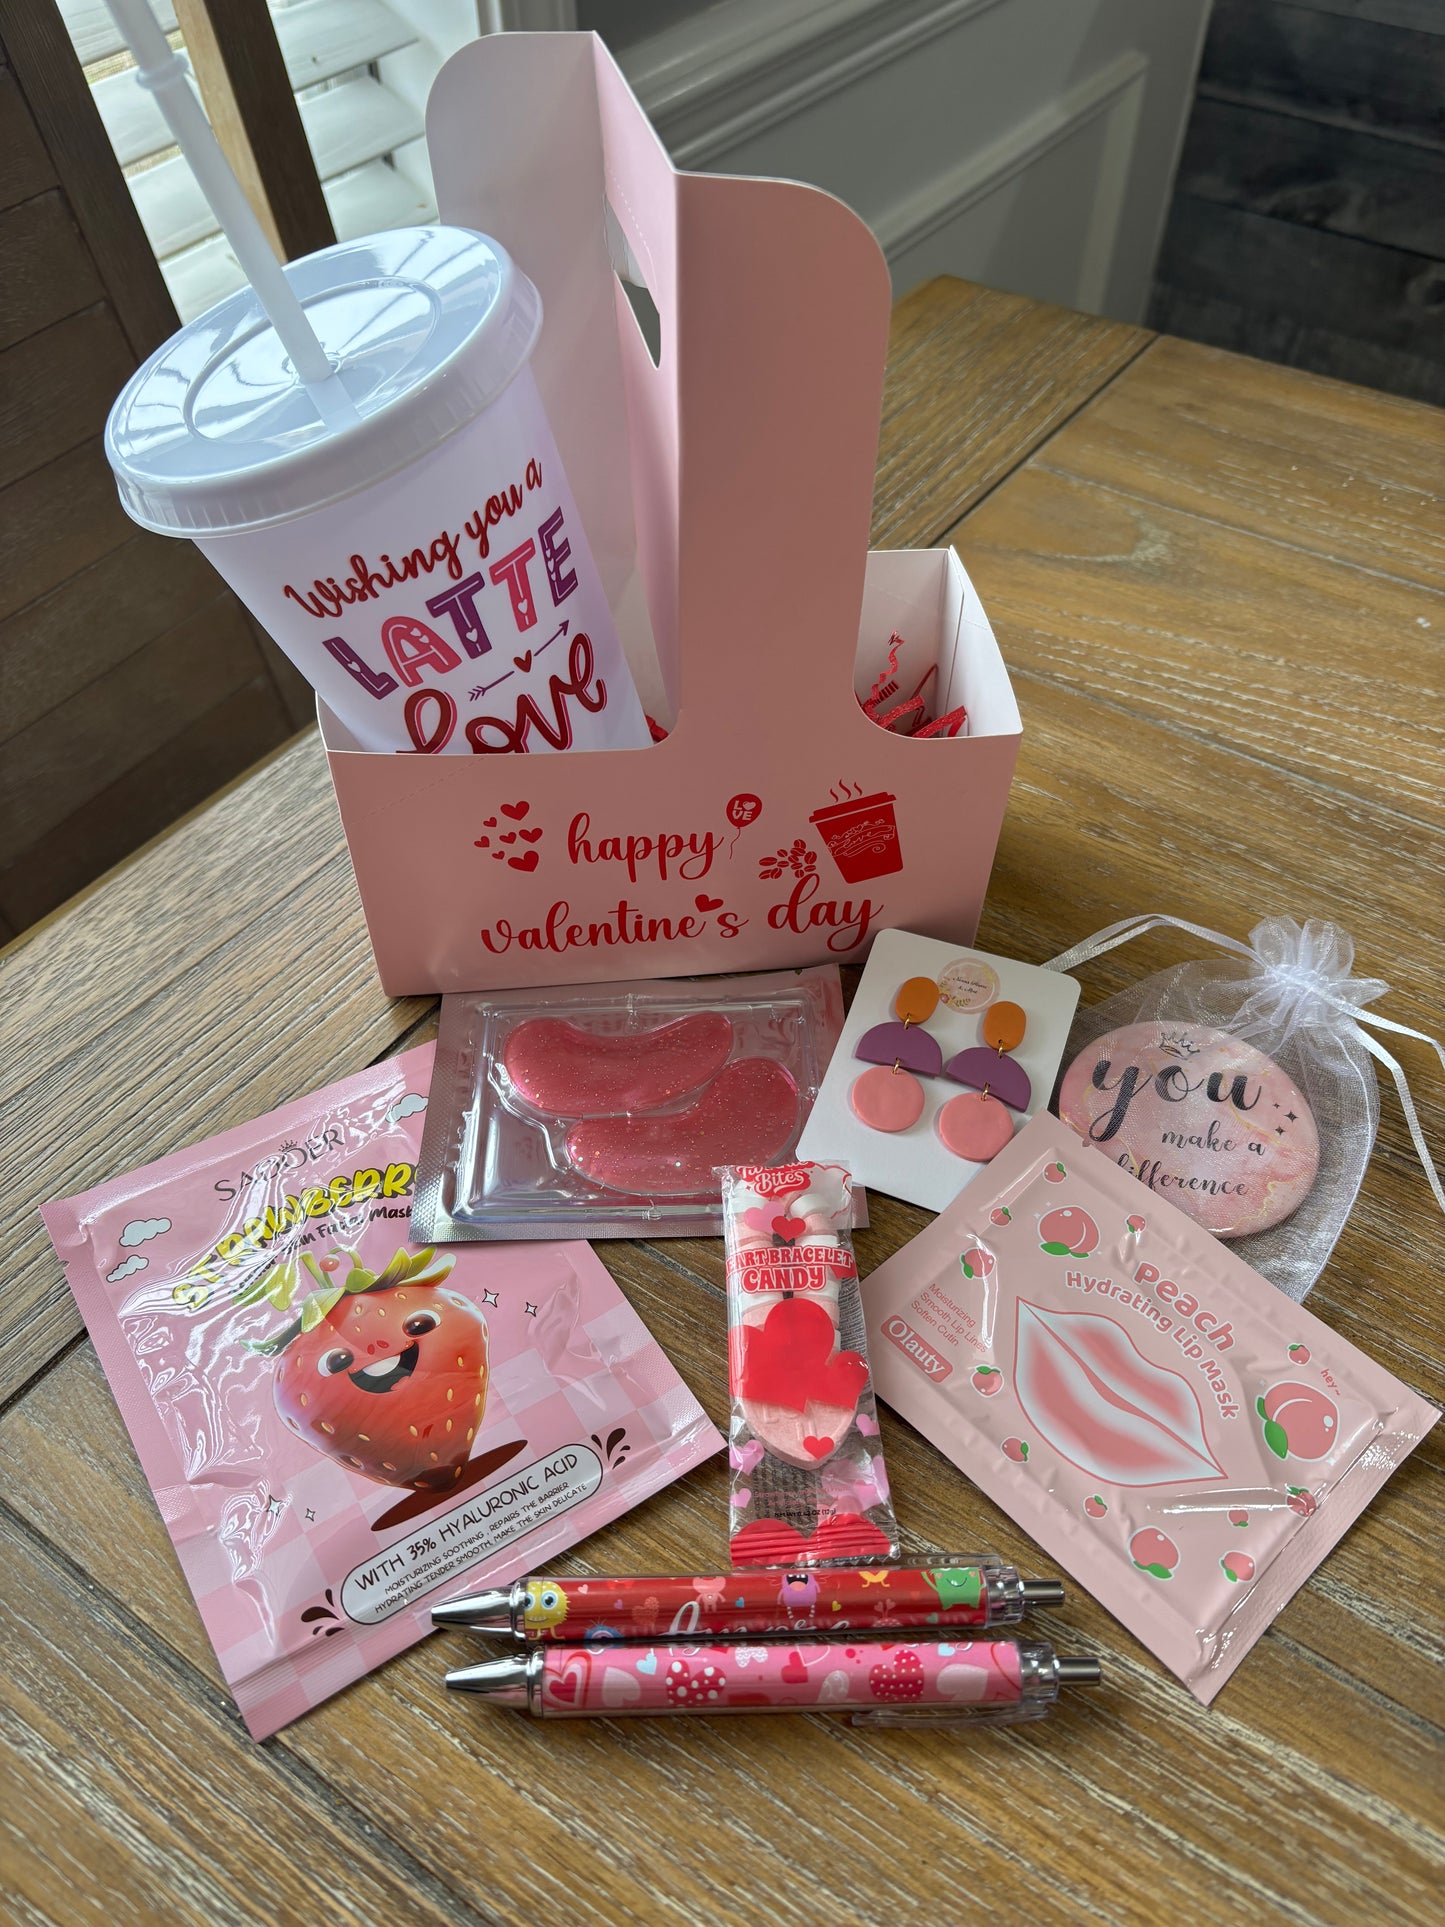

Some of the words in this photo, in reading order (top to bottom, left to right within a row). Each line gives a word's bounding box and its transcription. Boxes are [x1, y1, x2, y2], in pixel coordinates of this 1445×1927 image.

[284, 531, 460, 619] Wishing
[465, 484, 523, 559] you
[526, 457, 543, 491] a
[322, 506, 578, 700] LATTE
[568, 812, 725, 883] happy
[481, 894, 749, 954] valentine's
[767, 874, 884, 952] day
[1089, 1060, 1262, 1142] you
[1162, 1120, 1237, 1152] make
[1247, 1142, 1266, 1156] a
[755, 1171, 804, 1193] Bites
[173, 1163, 418, 1308] STRAWBERR
[742, 1265, 826, 1292] CANDY
[929, 1283, 976, 1328] Moisturizing
[888, 1319, 945, 1374] Olauty
[911, 1300, 938, 1327] Soften
[937, 1324, 960, 1346] Cutin
[921, 1292, 951, 1322] Smooth
[950, 1319, 965, 1335] Lip
[964, 1332, 986, 1353] Lines
[1066, 1272, 1173, 1333] Hydrating
[1173, 1327, 1203, 1359] Lip
[1199, 1359, 1240, 1418] Mask
[354, 1554, 406, 1591] WITH
[406, 1537, 437, 1561] 35%
[438, 1476, 539, 1543] HYALURONIC
[543, 1454, 579, 1483] ACID
[375, 1581, 423, 1614] HYDRATING
[423, 1562, 456, 1584] TENDER
[493, 1526, 517, 1543] MAKE
[517, 1516, 534, 1529] THE
[534, 1504, 552, 1520] SKIN
[551, 1483, 588, 1508] DELICATE
[384, 1556, 442, 1595] MOISTURIZING
[443, 1531, 485, 1560] SOOTHING
[489, 1510, 521, 1533] REPAIRS
[520, 1502, 538, 1514] THE
[538, 1481, 569, 1505] BARRIER
